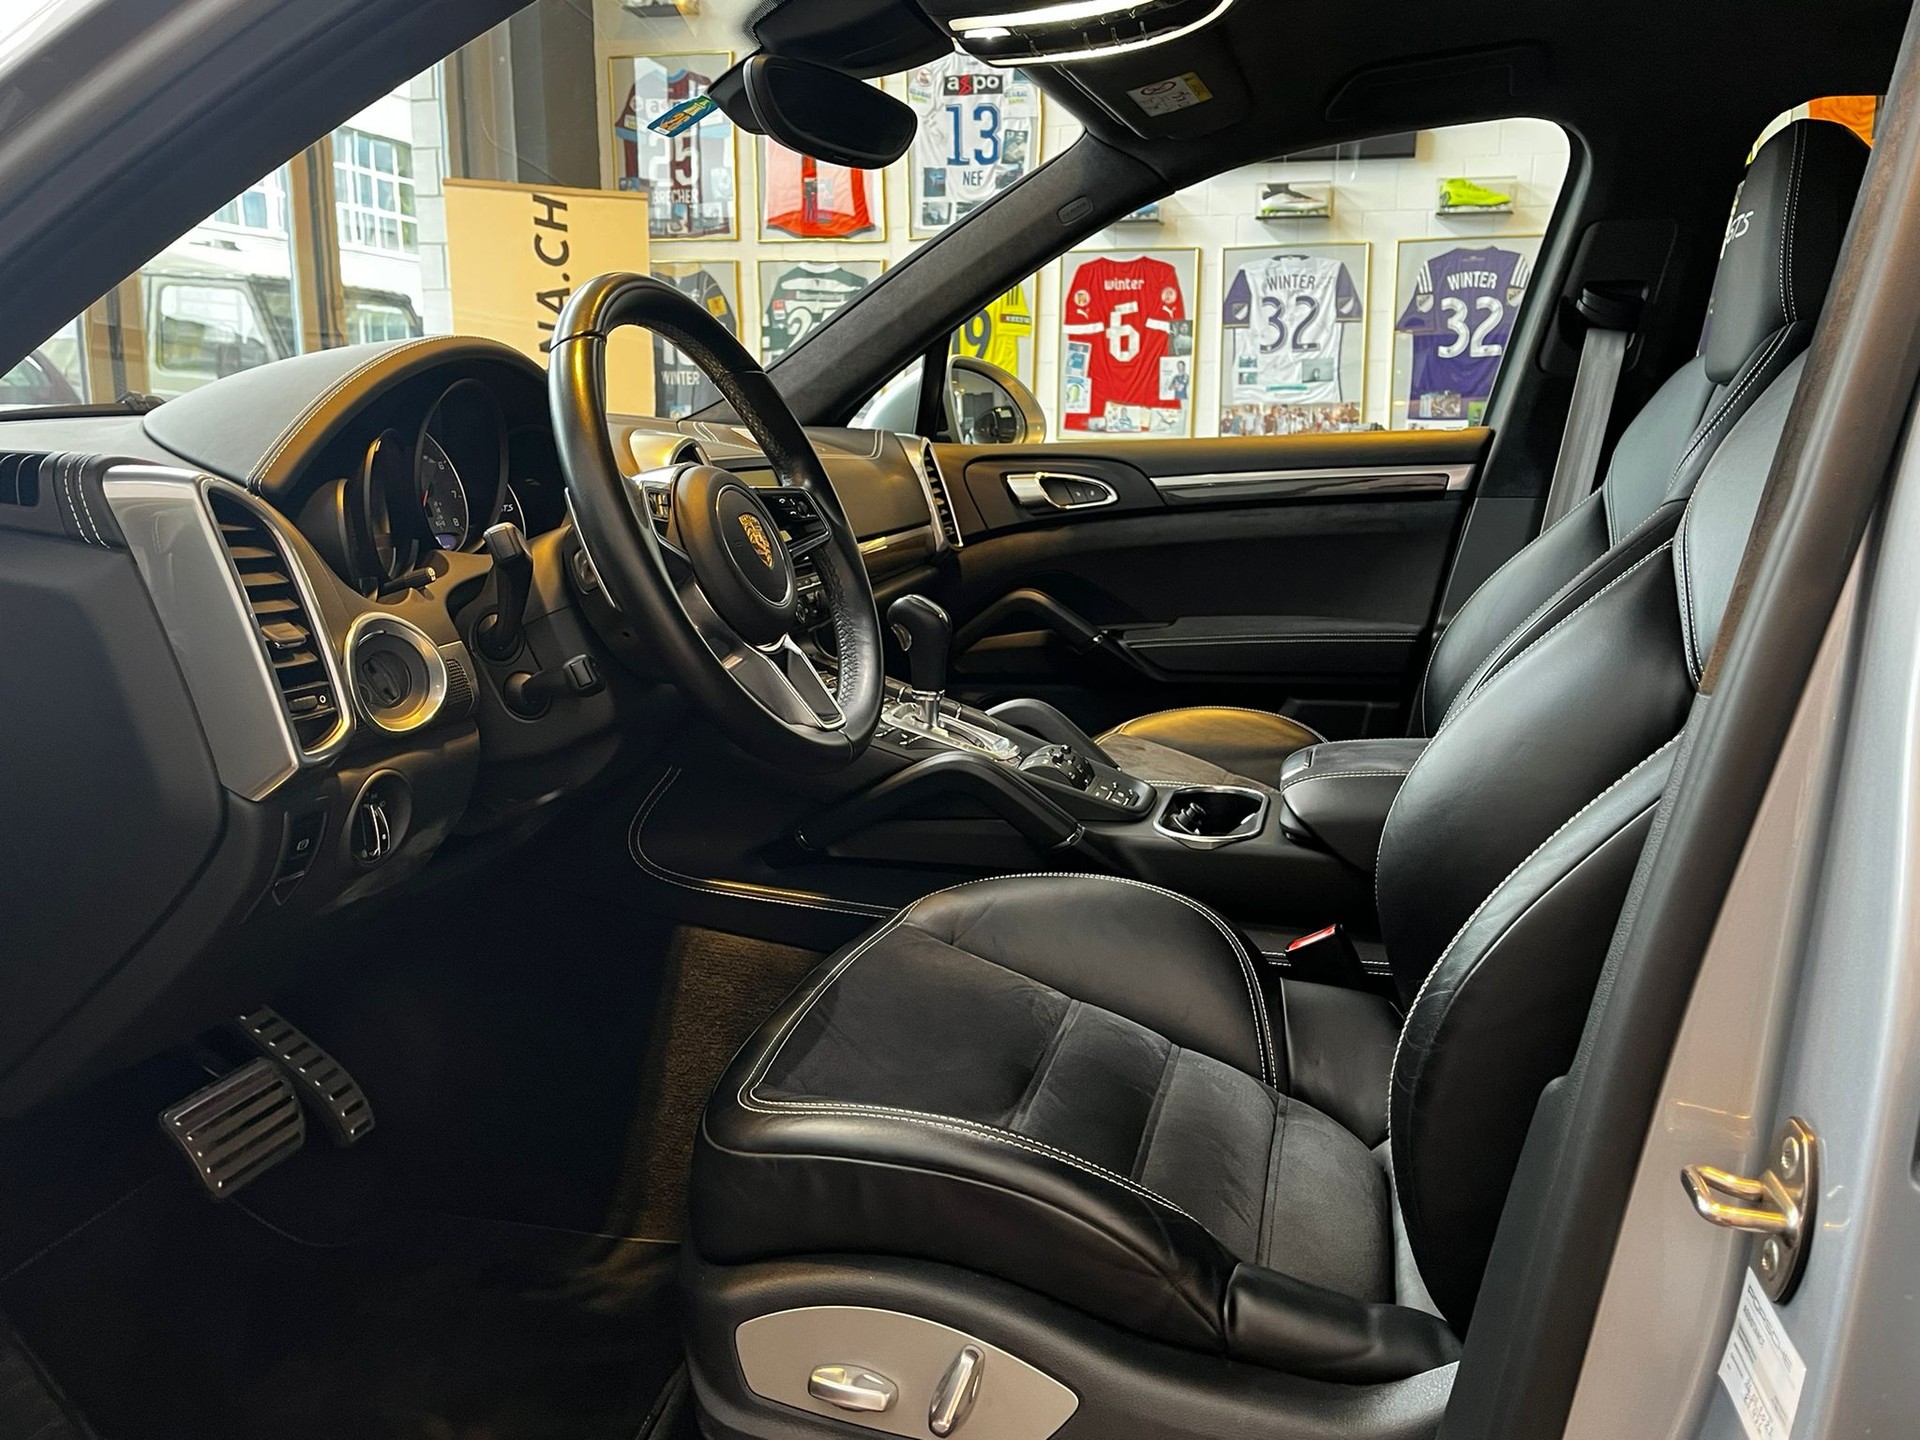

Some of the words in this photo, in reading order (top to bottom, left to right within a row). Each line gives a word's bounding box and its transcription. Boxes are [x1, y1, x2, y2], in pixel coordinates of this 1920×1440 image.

[945, 102, 1001, 166] 13
[962, 170, 984, 187] NEF
[652, 188, 699, 203] BRECHER
[1103, 277, 1145, 291] winter
[1266, 274, 1316, 291] WINTER
[1446, 271, 1498, 291] WINTER
[1106, 301, 1141, 362] 6
[1259, 294, 1320, 353] 32
[1437, 296, 1504, 358] 32
[660, 371, 701, 386] WINTER
[501, 503, 514, 512] TS
